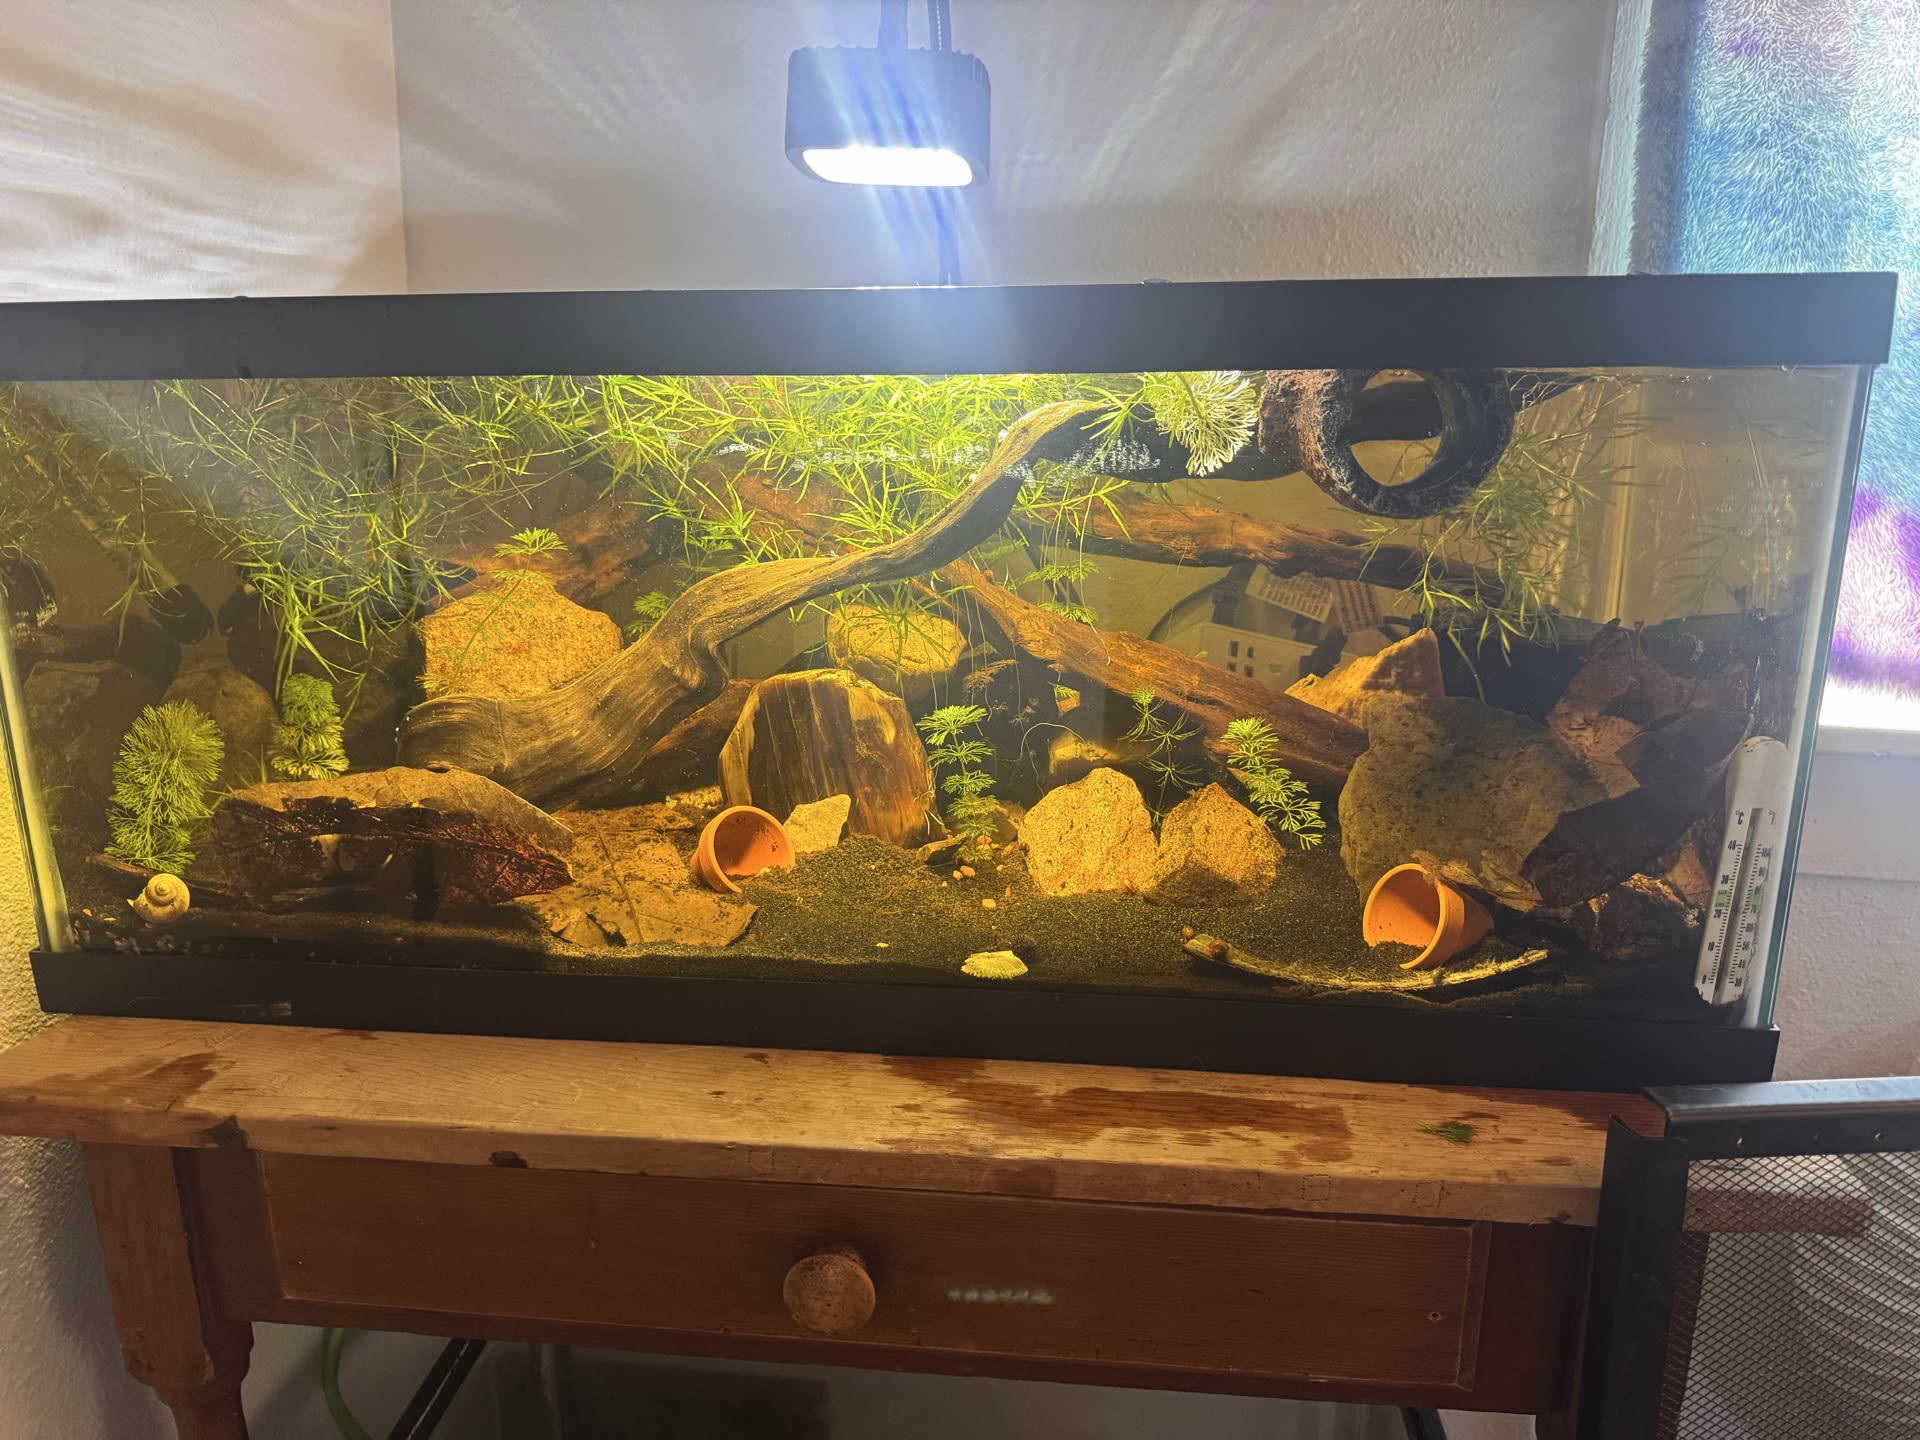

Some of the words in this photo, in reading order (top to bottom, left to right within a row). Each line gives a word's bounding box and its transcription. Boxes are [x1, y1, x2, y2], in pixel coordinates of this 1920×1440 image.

[1728, 840, 1737, 850] 40
[1721, 875, 1729, 884] 30
[1713, 909, 1722, 918] 20
[1708, 942, 1715, 951] 10
